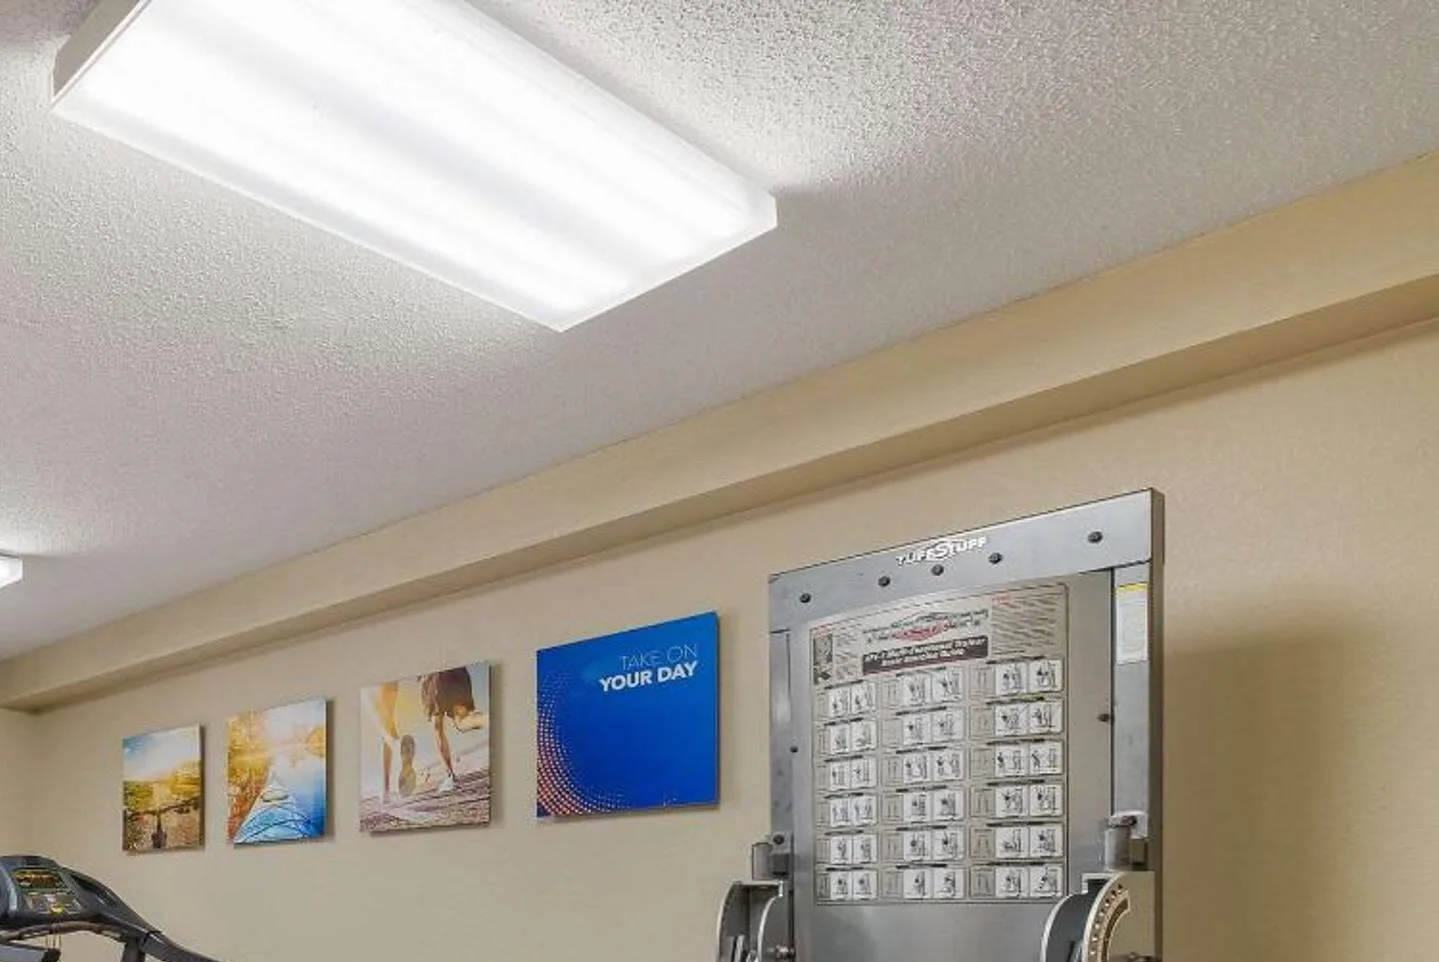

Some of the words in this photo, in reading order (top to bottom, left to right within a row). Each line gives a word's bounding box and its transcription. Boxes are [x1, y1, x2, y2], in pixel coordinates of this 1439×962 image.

[621, 653, 662, 671] TAKE
[667, 644, 698, 662] ON
[599, 669, 653, 693] YOUR
[657, 660, 698, 683] DAY
